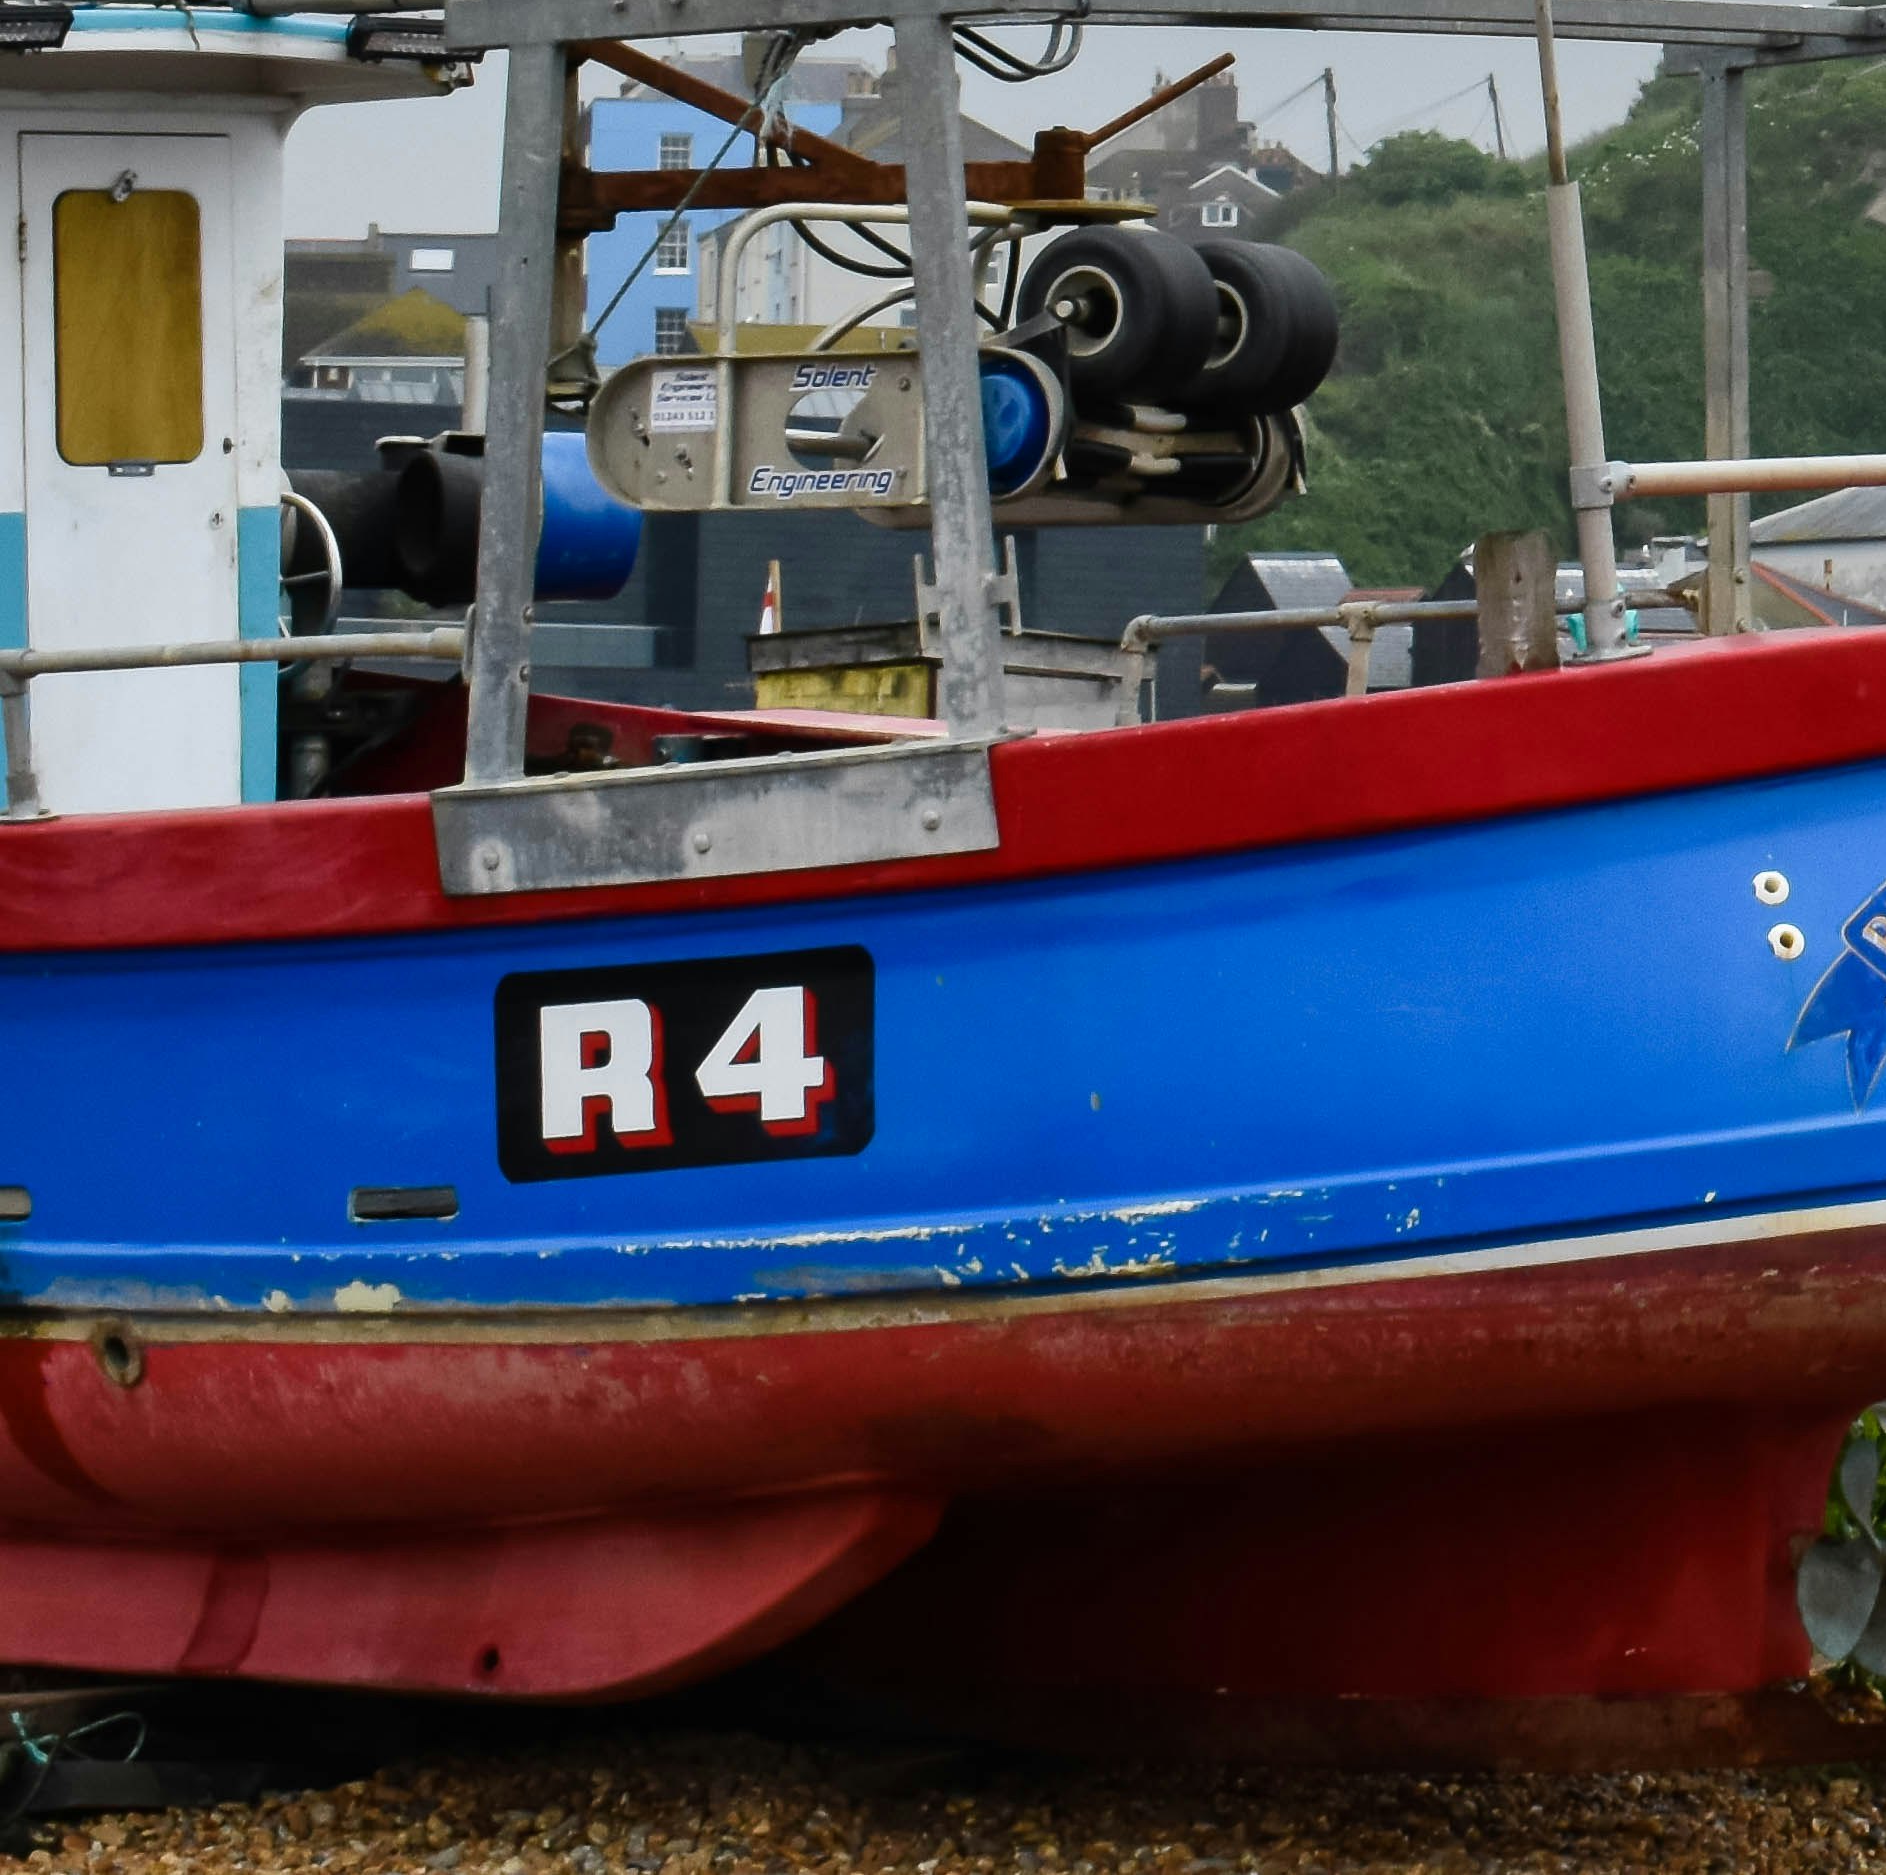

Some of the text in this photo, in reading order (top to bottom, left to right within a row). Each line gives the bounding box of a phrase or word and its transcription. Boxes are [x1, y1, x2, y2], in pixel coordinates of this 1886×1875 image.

[791, 363, 877, 389] Solent
[750, 467, 893, 497] Engineering
[540, 985, 837, 1153] R 4
